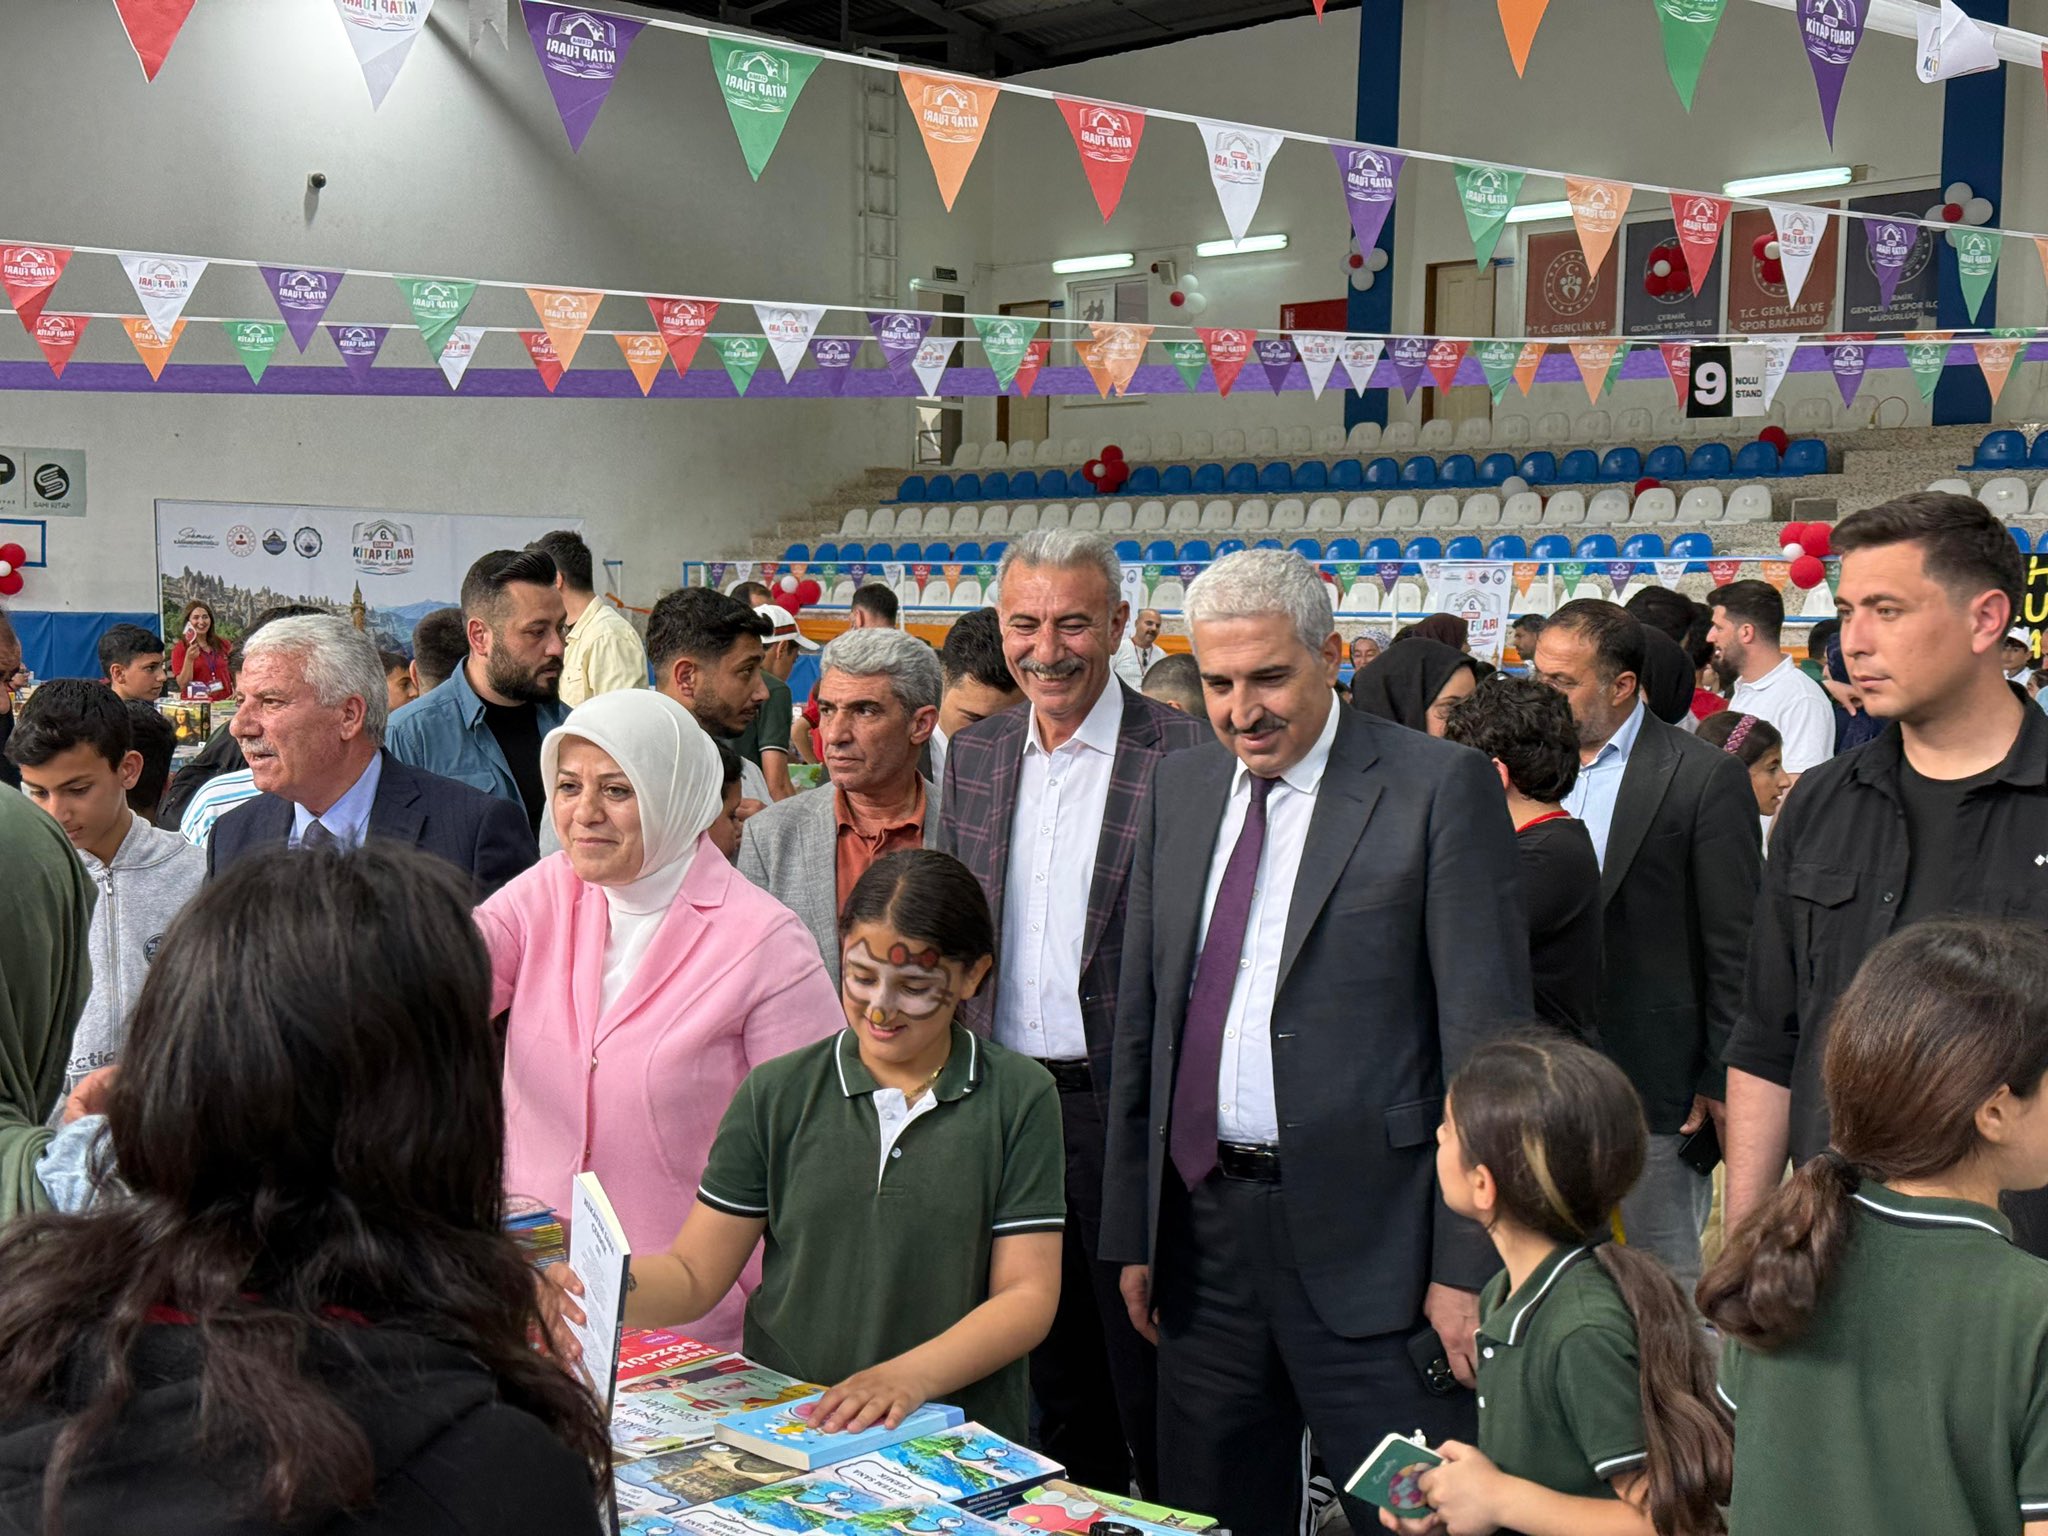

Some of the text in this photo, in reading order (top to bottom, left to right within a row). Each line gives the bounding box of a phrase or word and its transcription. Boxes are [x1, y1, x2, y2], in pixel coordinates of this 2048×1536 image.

[1805, 17, 1855, 45] KİTAP FUARI
[1923, 56, 1940, 73] KİT
[1810, 302, 1825, 312] VE
[1901, 301, 1924, 310] SPOR
[1551, 321, 1592, 334] GENÇLİK
[1594, 320, 1607, 330] VE
[1674, 320, 1694, 329] SPOR
[1739, 315, 1825, 331] SPOR BAKANLIĞI
[1694, 362, 1727, 406] 9
[1735, 376, 1759, 385] NOLU
[1735, 389, 1763, 398] STAND
[380, 530, 389, 540] 6.
[353, 545, 414, 560] KİTAP FUARI
[1470, 618, 1499, 632] FUARI
[654, 1347, 719, 1370] Neşeli
